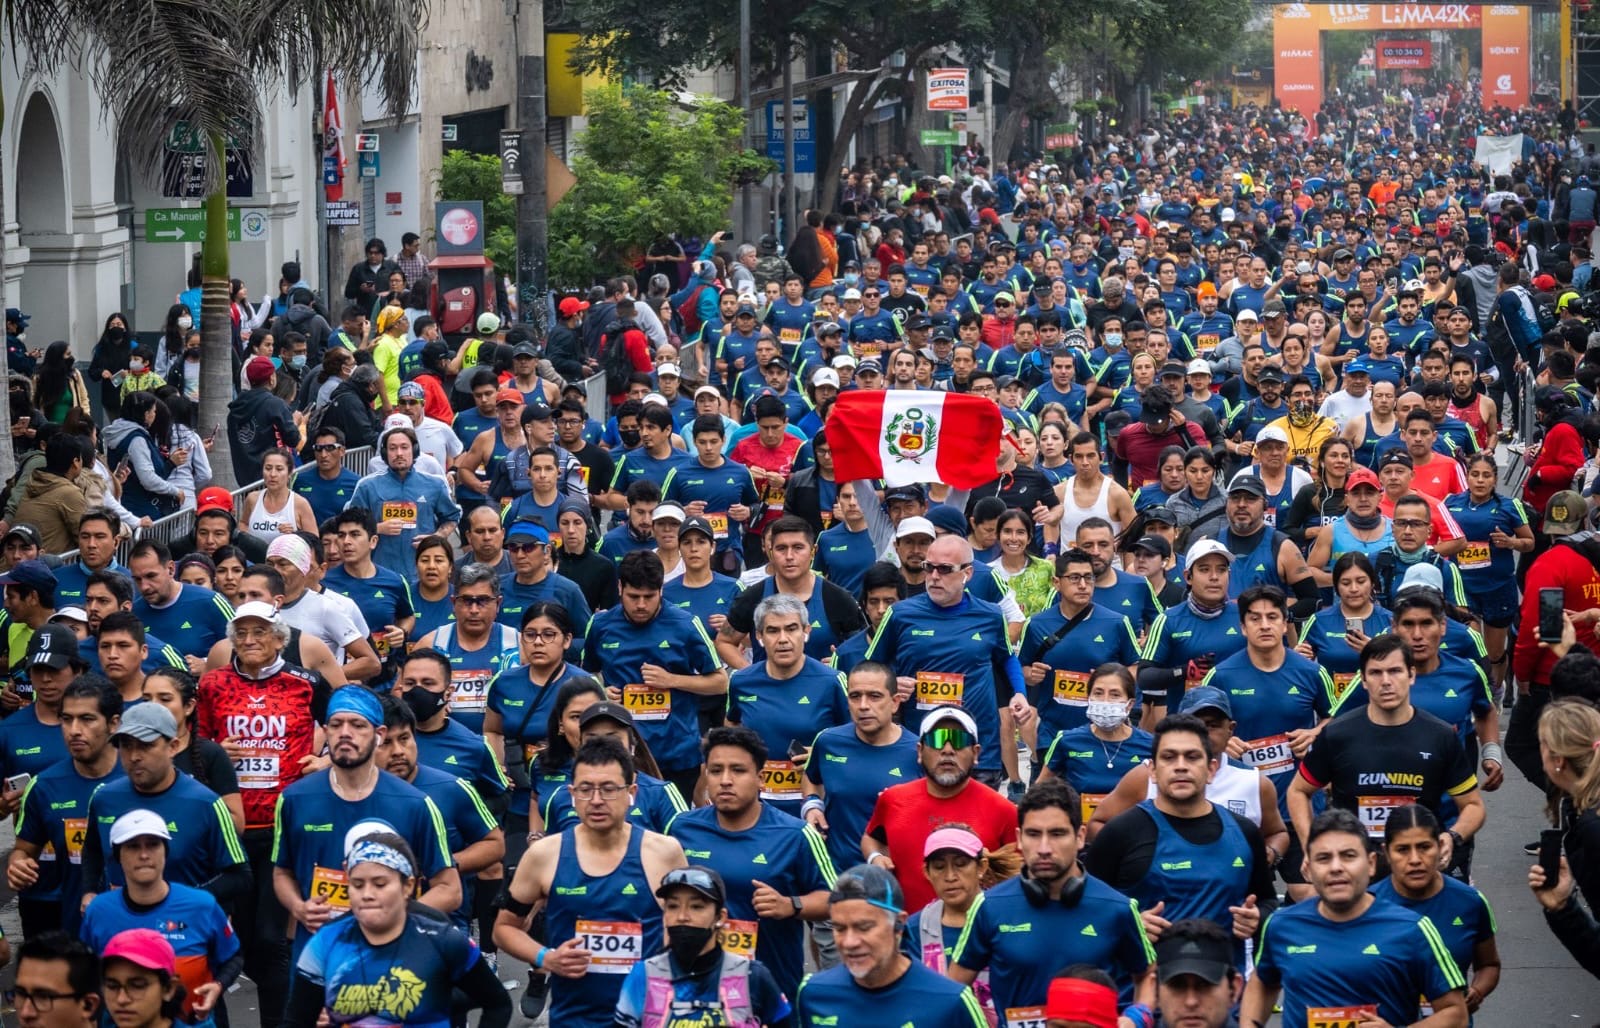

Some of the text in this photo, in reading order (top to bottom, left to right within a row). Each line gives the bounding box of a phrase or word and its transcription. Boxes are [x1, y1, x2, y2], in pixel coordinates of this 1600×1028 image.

[930, 79, 965, 87] EXITOSA
[772, 130, 810, 140] PAERO
[154, 212, 168, 221] Ca.
[170, 211, 202, 221] Manuel
[327, 209, 359, 218] LAPTOPS
[385, 508, 415, 518] 8289
[1458, 548, 1488, 559] 4244
[920, 682, 958, 696] 8201
[629, 693, 666, 706] 7139
[227, 715, 286, 738] IRON
[235, 738, 287, 750] ARRIORS
[1248, 745, 1284, 763] 1681
[236, 758, 273, 771] 2133
[1357, 772, 1424, 786] RUNNING
[582, 934, 635, 952] 1304
